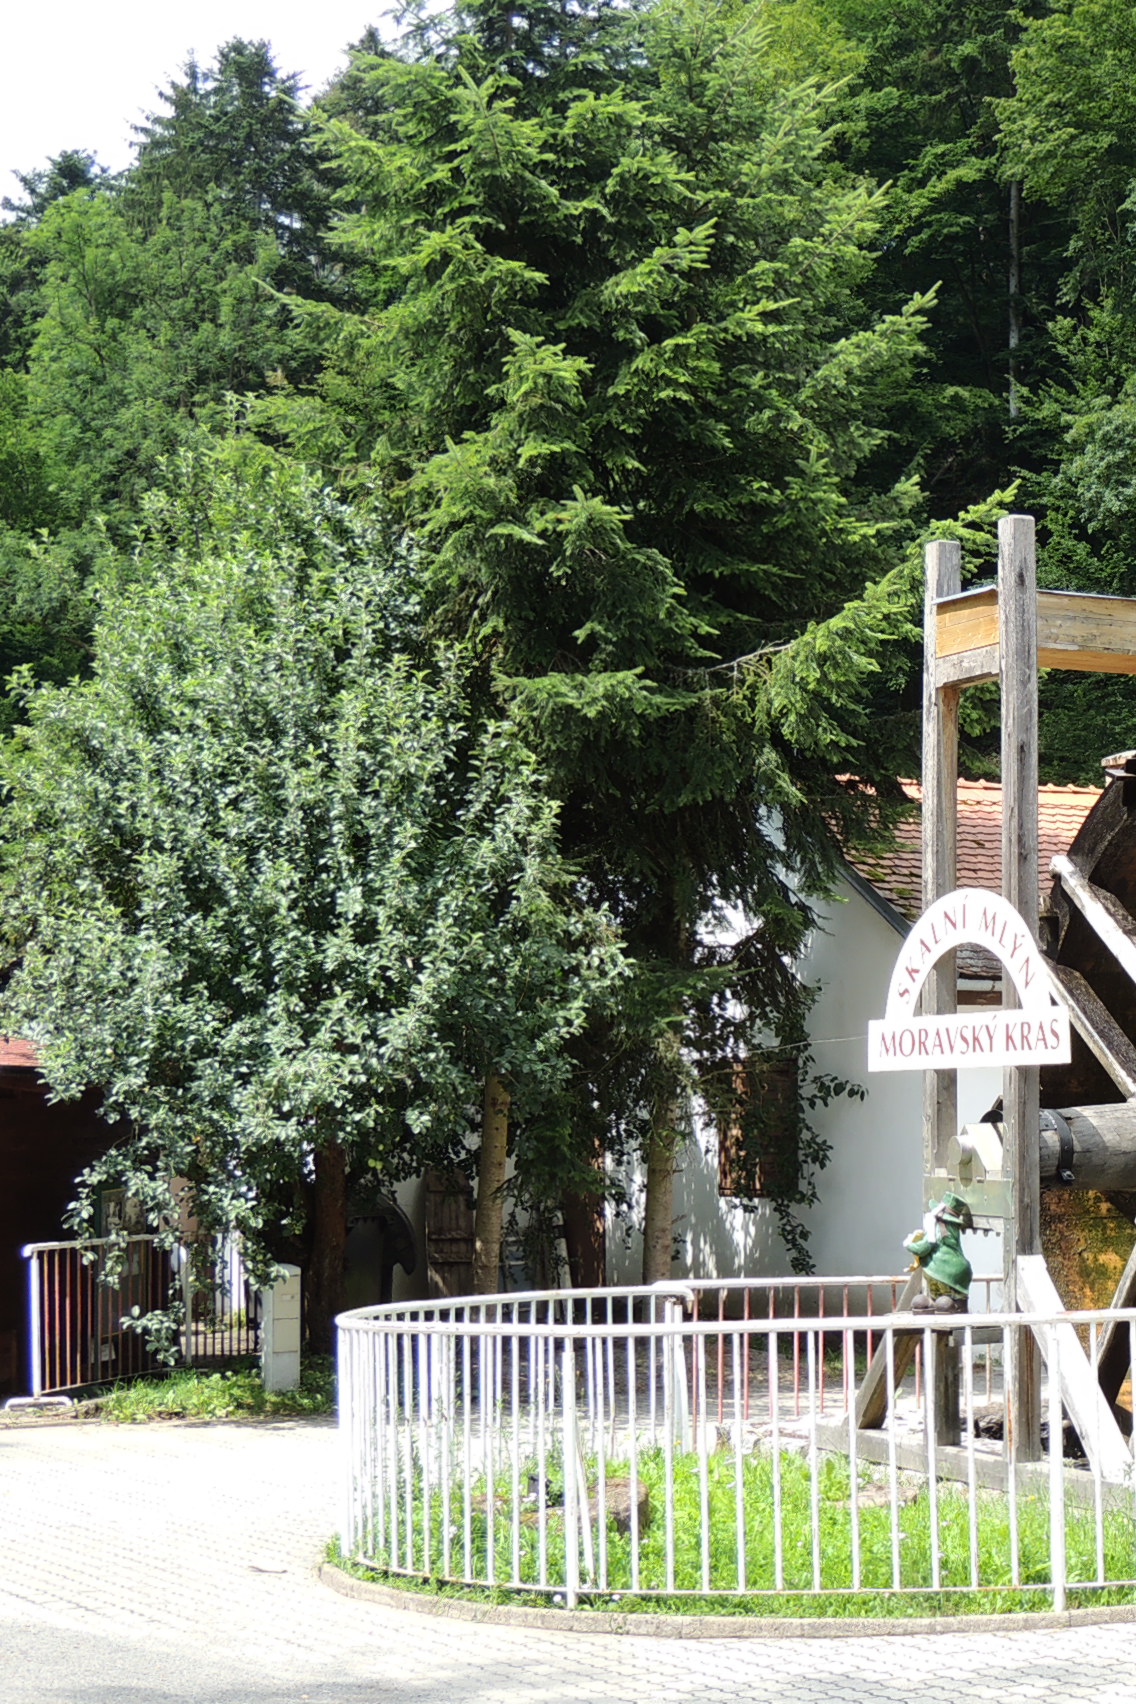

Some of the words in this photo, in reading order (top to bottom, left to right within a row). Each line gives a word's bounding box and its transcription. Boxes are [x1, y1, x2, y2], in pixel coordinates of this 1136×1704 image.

[897, 895, 968, 1004] SKALNÍ
[978, 906, 1036, 990] MLÝN
[879, 1015, 998, 1058] MORAVSKÝ
[1005, 1018, 1061, 1052] KRAS
